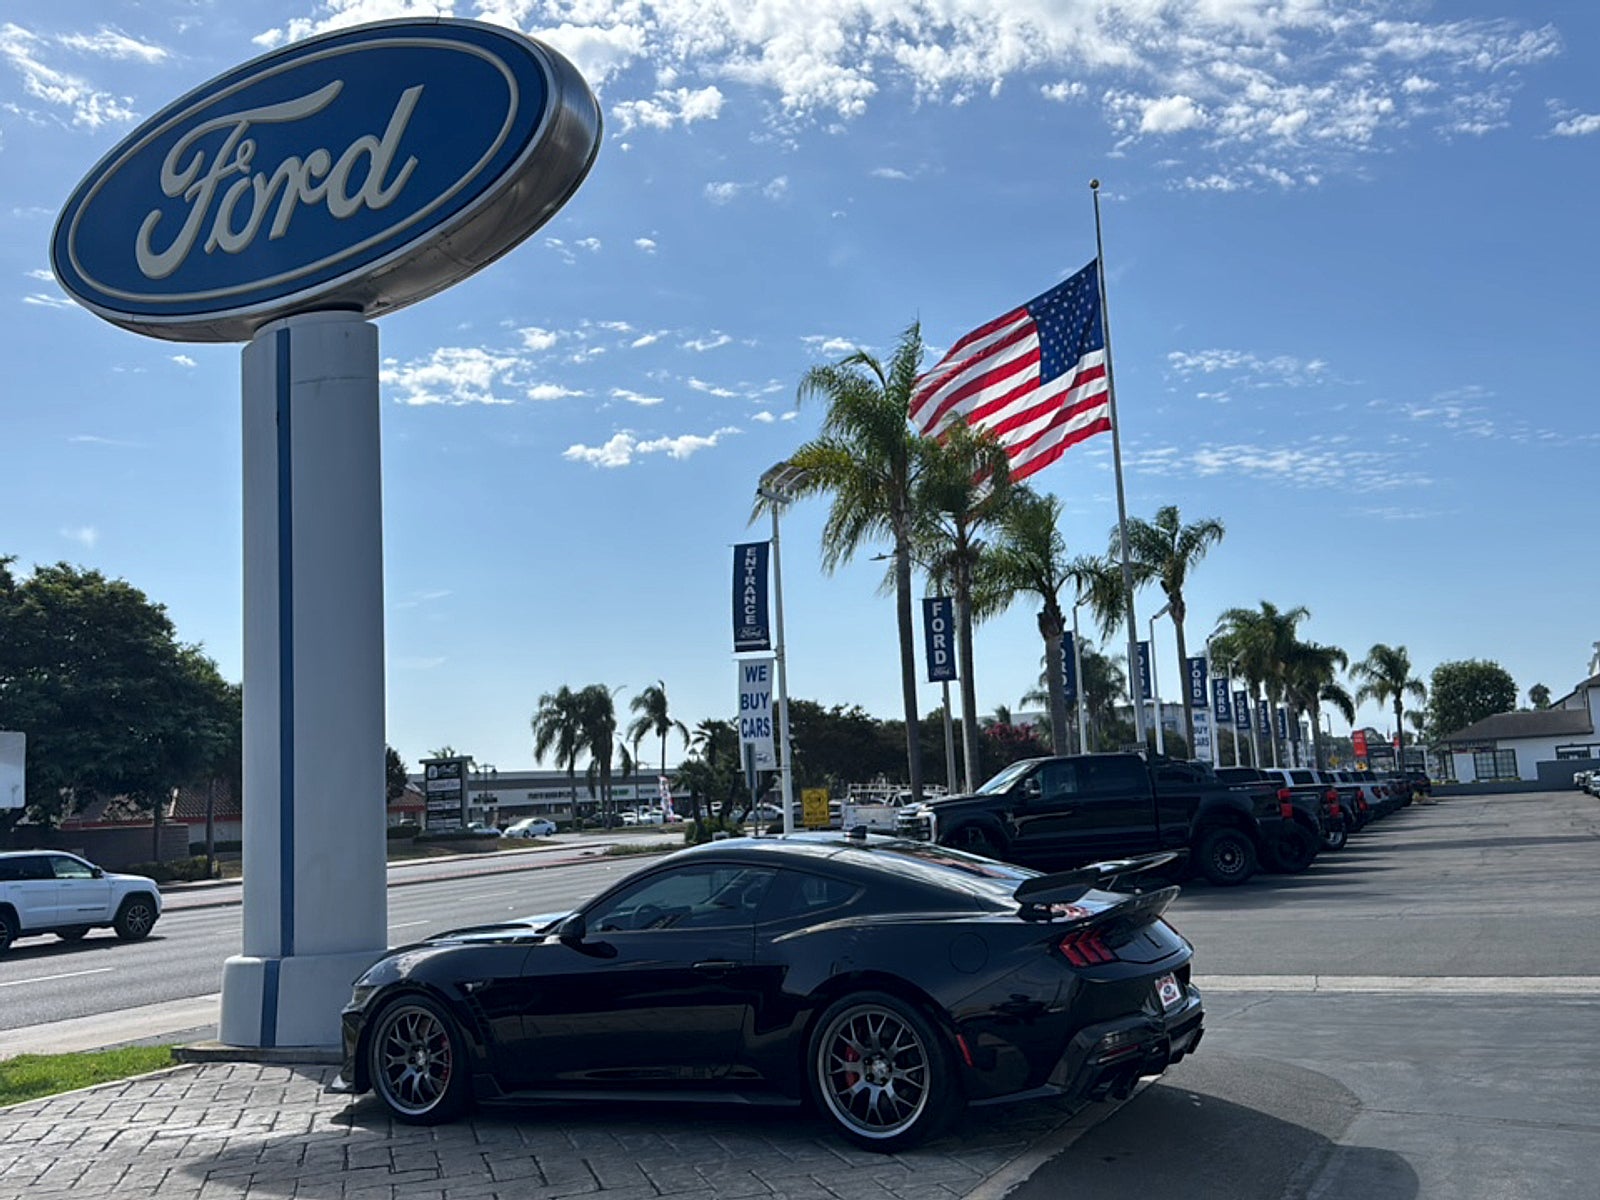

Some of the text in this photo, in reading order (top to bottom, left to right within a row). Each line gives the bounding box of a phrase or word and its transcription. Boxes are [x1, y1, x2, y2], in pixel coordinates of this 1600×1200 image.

[135, 79, 424, 280] Ford
[744, 547, 757, 625] ENTRANCE
[931, 601, 948, 665] FORD
[745, 665, 767, 683] WE
[1191, 660, 1202, 698] FORD
[740, 692, 770, 710] BUY
[1216, 681, 1226, 713] FORD
[741, 717, 771, 738] CARS
